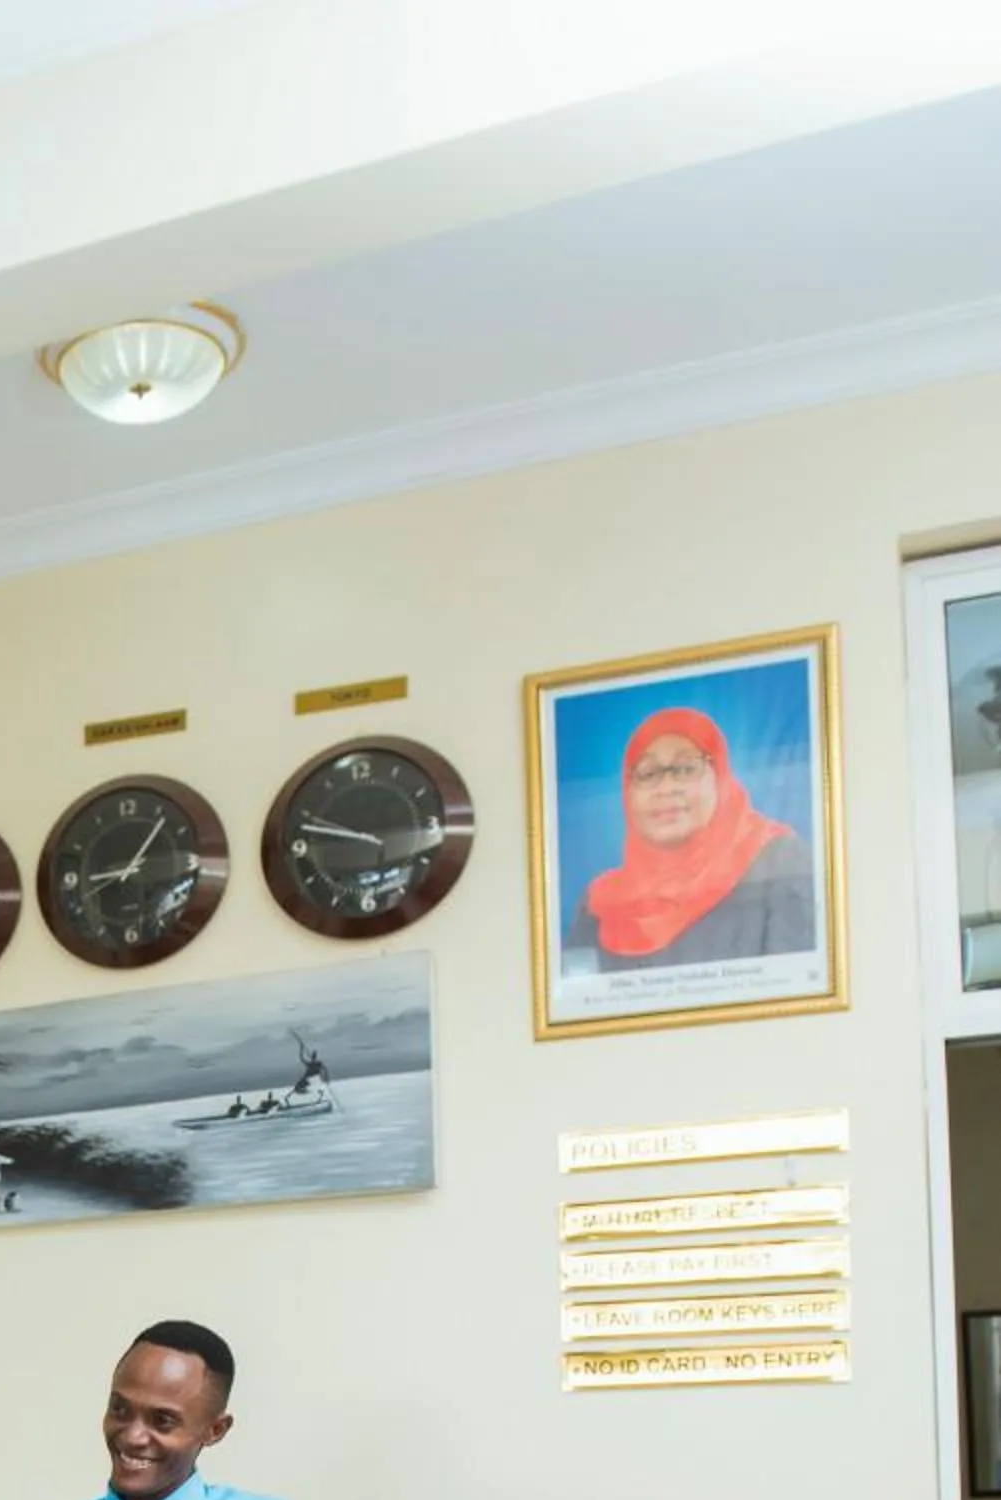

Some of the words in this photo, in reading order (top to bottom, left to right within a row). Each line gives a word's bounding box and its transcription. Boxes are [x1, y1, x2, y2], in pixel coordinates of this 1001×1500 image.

[351, 761, 370, 780] 12
[119, 799, 137, 816] 12
[428, 815, 440, 834] 3
[292, 838, 308, 858] 9
[188, 852, 199, 870] 3
[64, 871, 78, 889] 9
[360, 890, 377, 912] 6
[125, 925, 139, 943] 6
[572, 1134, 696, 1161] POLICIES
[584, 1309, 642, 1328] LEAVE
[654, 1306, 714, 1324] ROOM
[721, 1302, 775, 1320] KEYS
[583, 1360, 614, 1375] NO
[620, 1358, 639, 1374] ID
[647, 1355, 706, 1373] CARD
[725, 1353, 756, 1370] NO
[764, 1350, 835, 1370] ENTRY
